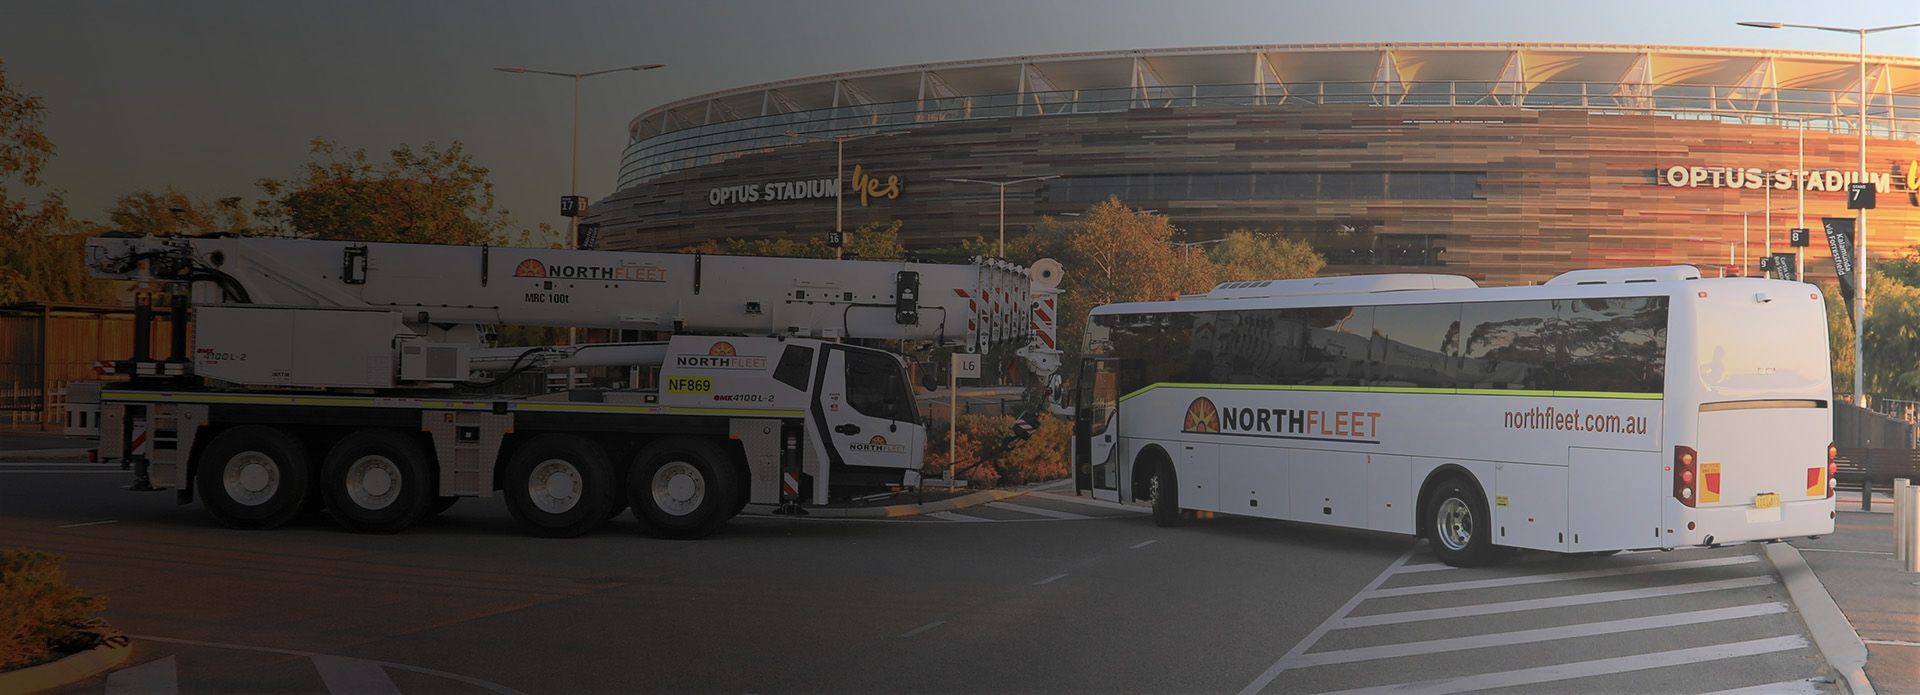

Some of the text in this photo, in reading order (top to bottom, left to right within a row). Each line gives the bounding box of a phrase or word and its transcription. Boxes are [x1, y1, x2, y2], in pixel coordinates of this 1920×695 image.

[1667, 166, 1763, 189] OPTUS
[709, 178, 839, 206] OPTUS STADIUM
[1852, 189, 1860, 201] 7
[562, 201, 573, 211] 17
[829, 235, 840, 243] 16
[1792, 232, 1799, 242] 8
[1761, 259, 1767, 268] 9
[549, 265, 667, 281] NORTHFLEET
[525, 293, 569, 304] MRC 100t
[677, 357, 767, 368] NORTHFLEET
[963, 361, 975, 371] L6
[669, 379, 711, 391] NF869
[1223, 407, 1381, 438] NORTHFLEET
[1504, 407, 1647, 434] northfleet.com.au
